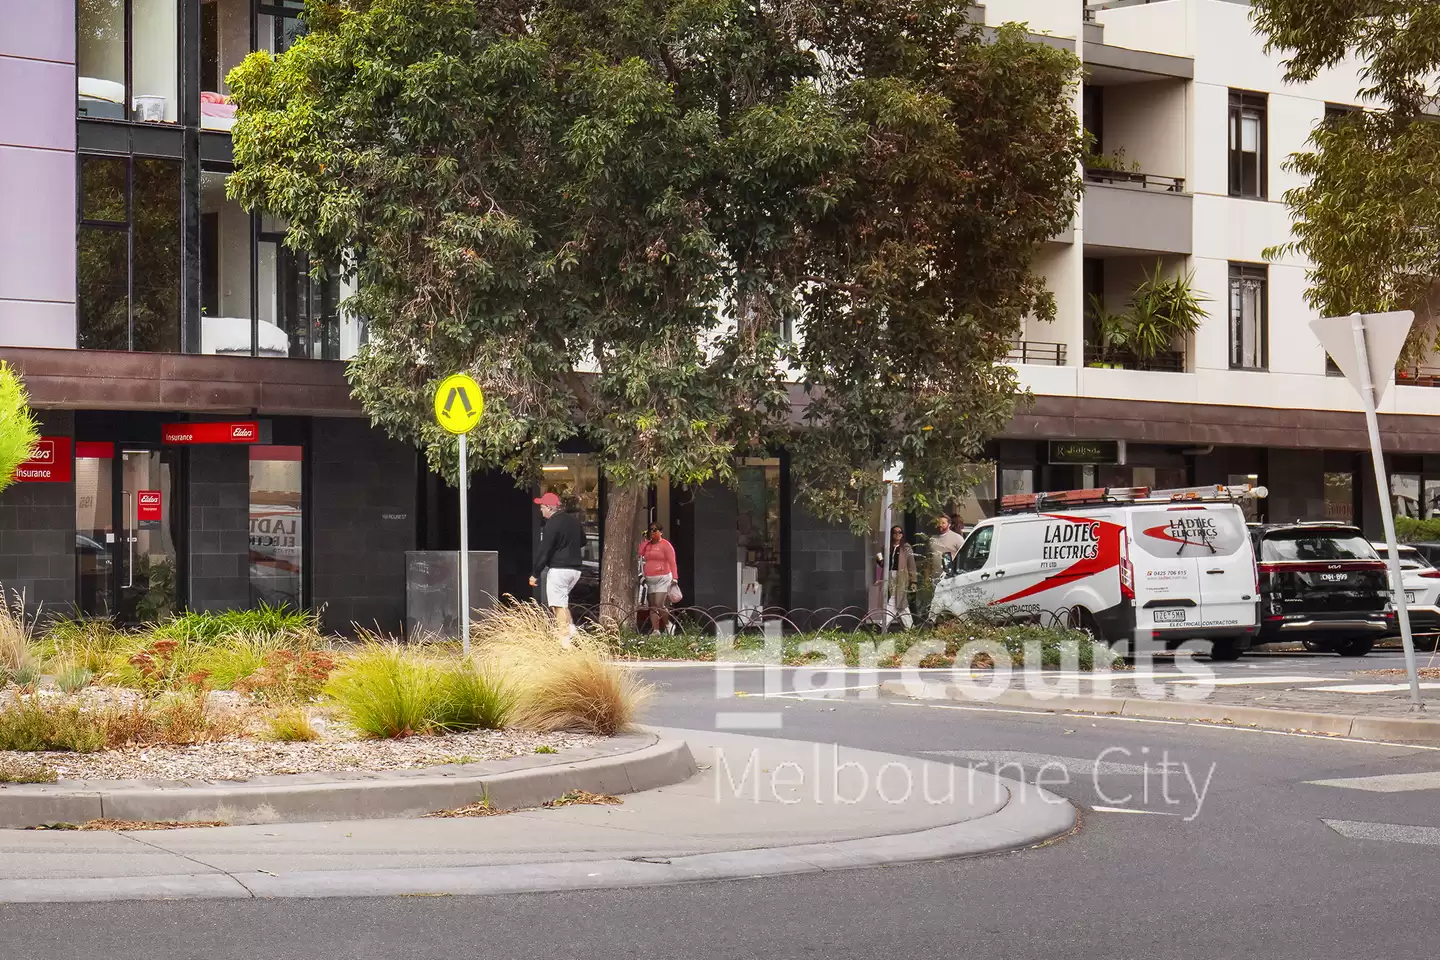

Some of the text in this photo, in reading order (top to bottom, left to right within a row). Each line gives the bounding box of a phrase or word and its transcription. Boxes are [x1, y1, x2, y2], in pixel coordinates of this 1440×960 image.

[166, 433, 193, 441] Insurance
[232, 427, 253, 437] Elders
[16, 468, 51, 478] Insurance
[140, 495, 159, 503] Elders
[1169, 518, 1216, 529] LADTEC
[1044, 521, 1100, 544] LADTEC
[1171, 528, 1218, 538] ELECTRICS
[1043, 544, 1099, 560] ELECTRICS
